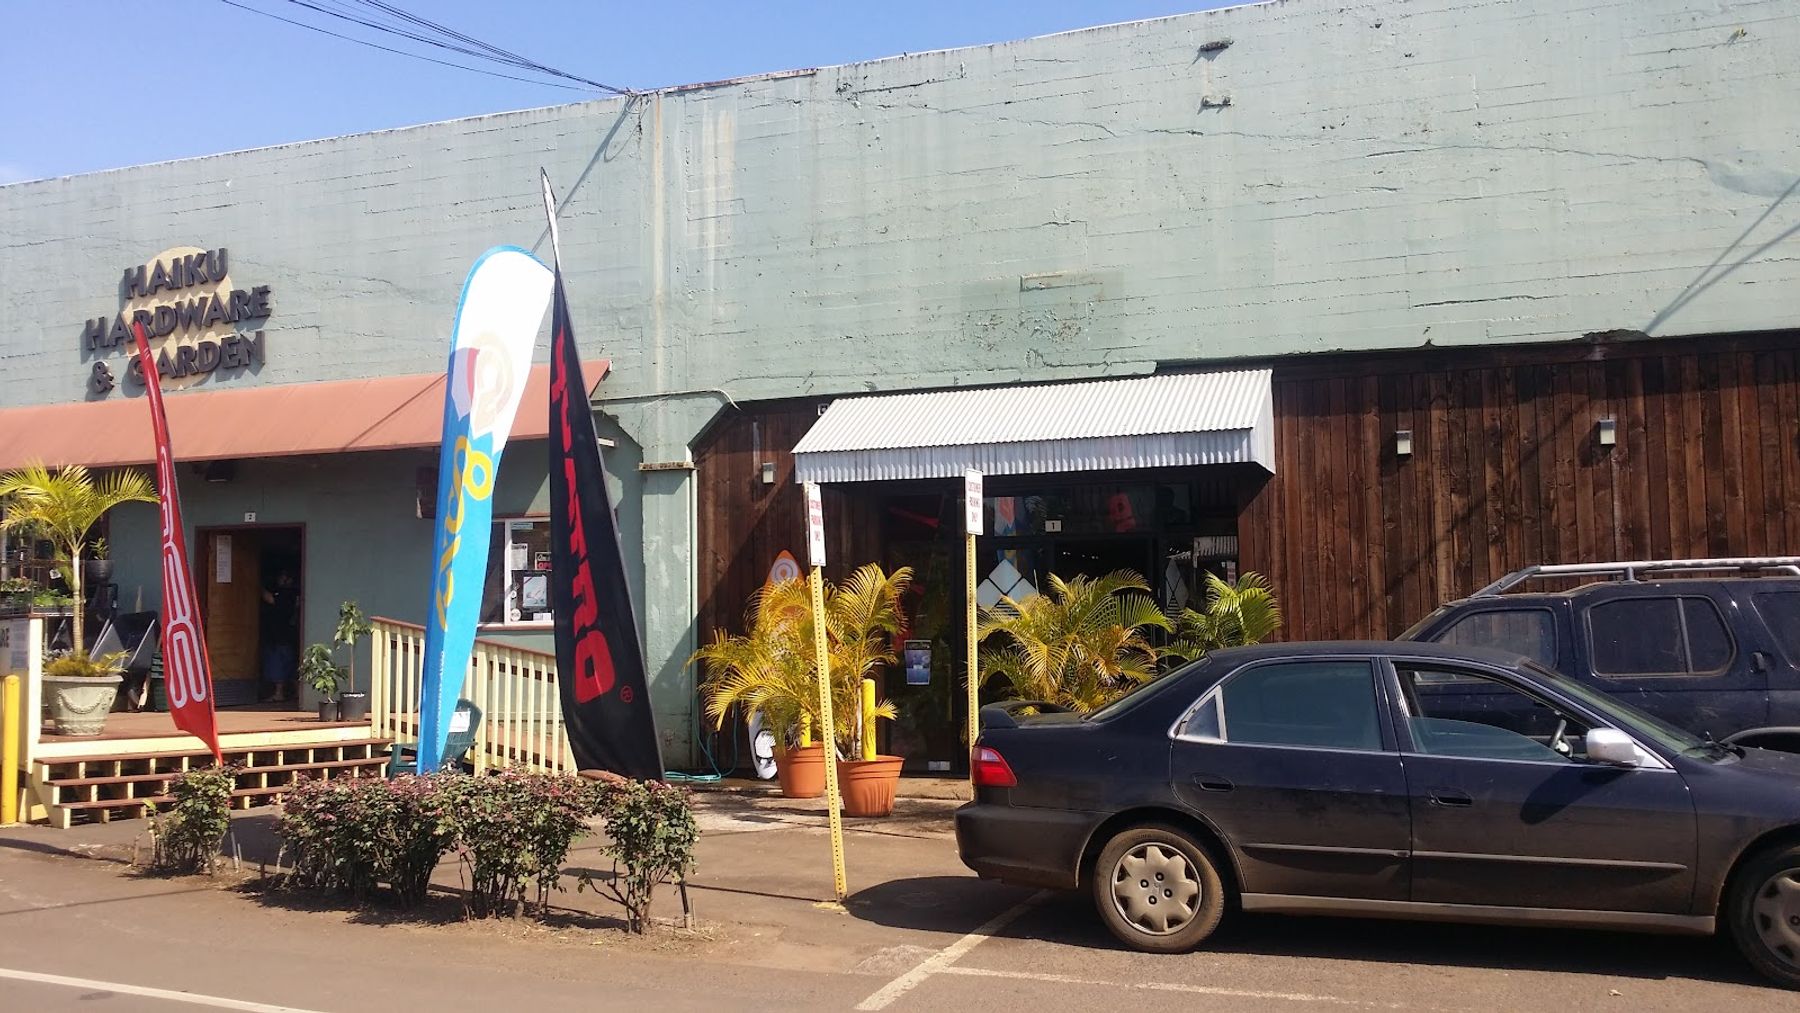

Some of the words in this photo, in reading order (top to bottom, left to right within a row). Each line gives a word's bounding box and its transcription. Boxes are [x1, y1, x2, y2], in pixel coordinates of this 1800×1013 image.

[124, 248, 228, 299] HAIKU
[85, 285, 272, 350] HARDWARE
[92, 361, 115, 393] &
[127, 331, 266, 387] GARDEN
